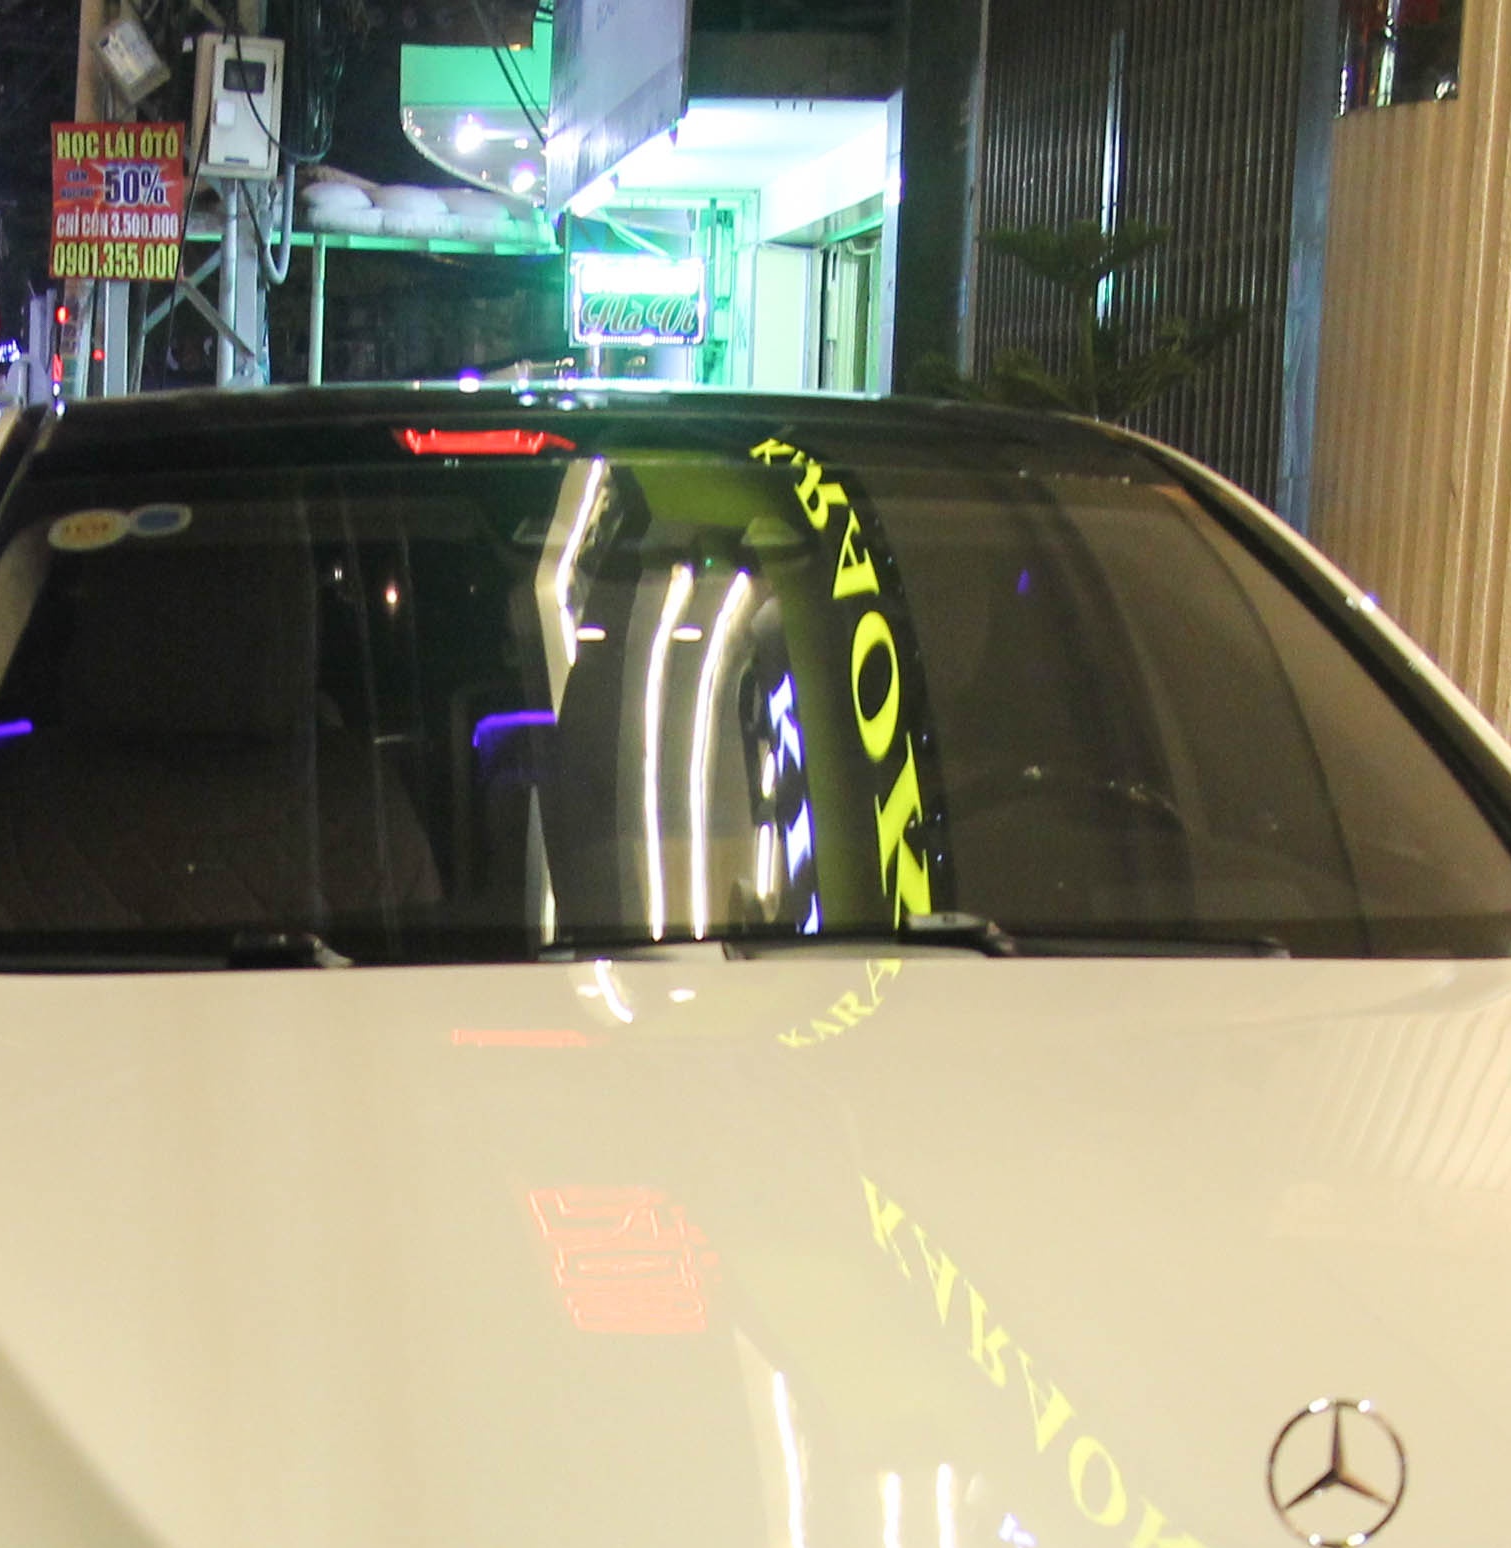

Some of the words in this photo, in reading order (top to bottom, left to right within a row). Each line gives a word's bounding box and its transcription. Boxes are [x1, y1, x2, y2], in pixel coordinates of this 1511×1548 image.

[57, 131, 100, 166] HỌC
[104, 126, 135, 159] LÁI
[104, 167, 165, 205] 50%
[111, 212, 179, 239] 3.500.000
[53, 241, 180, 280] 0901.355.000
